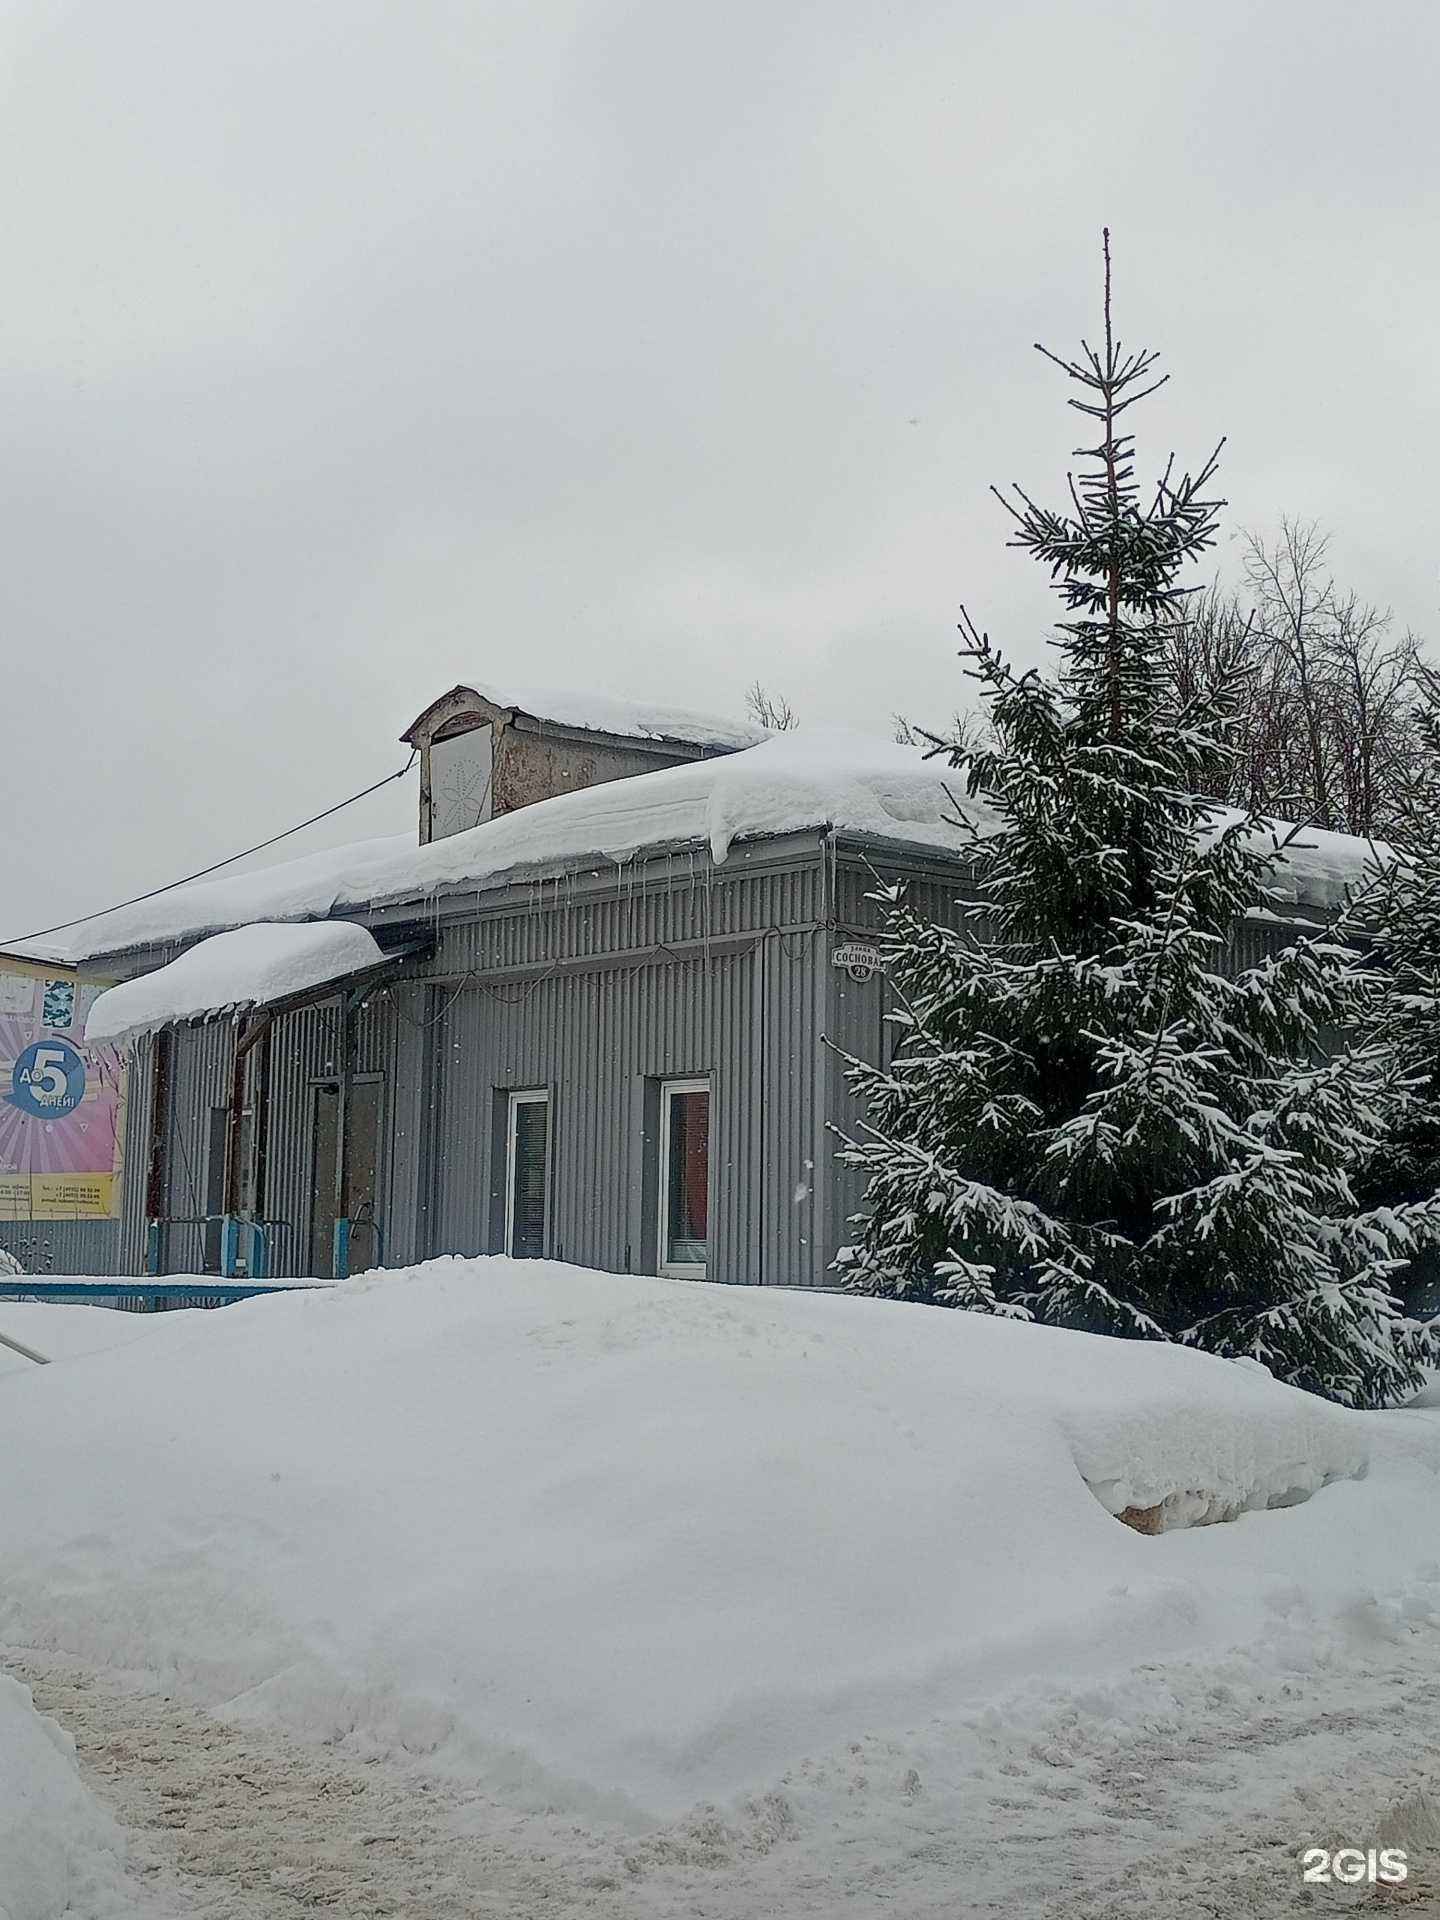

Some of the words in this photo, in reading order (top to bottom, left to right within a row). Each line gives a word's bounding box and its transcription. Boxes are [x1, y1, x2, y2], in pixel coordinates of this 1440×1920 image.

[836, 952, 879, 967] СОСНОВА
[854, 967, 867, 977] 28
[30, 1048, 68, 1104] 5
